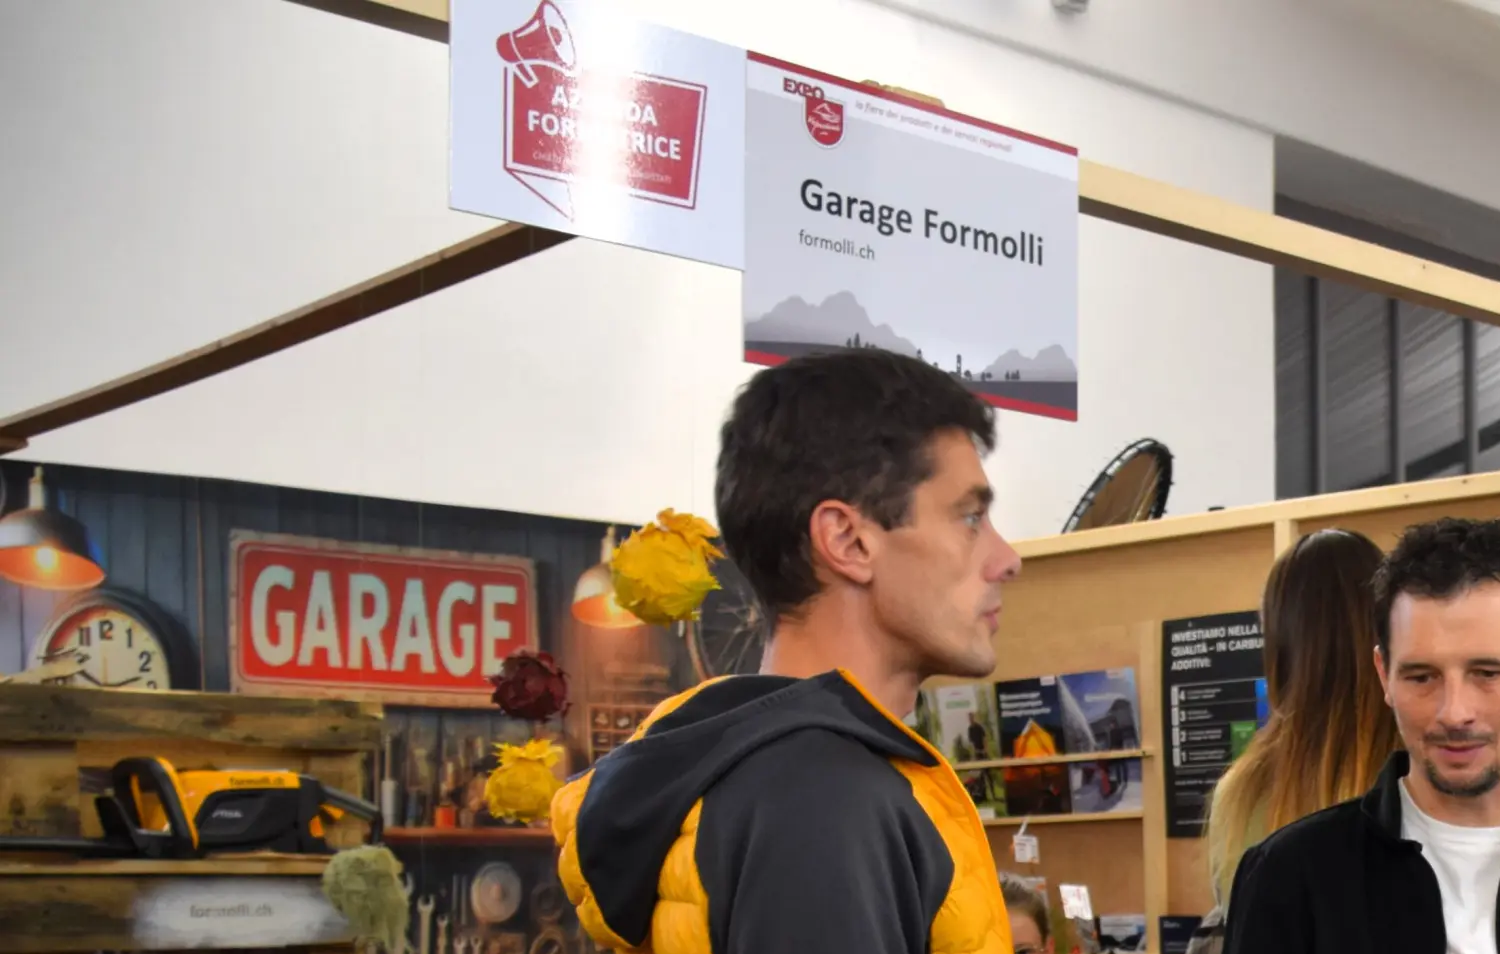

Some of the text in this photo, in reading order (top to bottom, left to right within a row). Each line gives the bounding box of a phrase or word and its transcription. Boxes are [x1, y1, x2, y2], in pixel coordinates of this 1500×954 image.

[783, 77, 825, 100] EXPO
[552, 85, 657, 127] AZDA
[528, 110, 681, 160] FORRICE
[800, 178, 1044, 267] Garage Formolli
[798, 228, 875, 261] formolli.ch
[251, 564, 518, 678] GARAGE
[1171, 623, 1258, 643] INVESTIAMO NELLA
[138, 650, 151, 673] 2
[1215, 641, 1227, 652] IN
